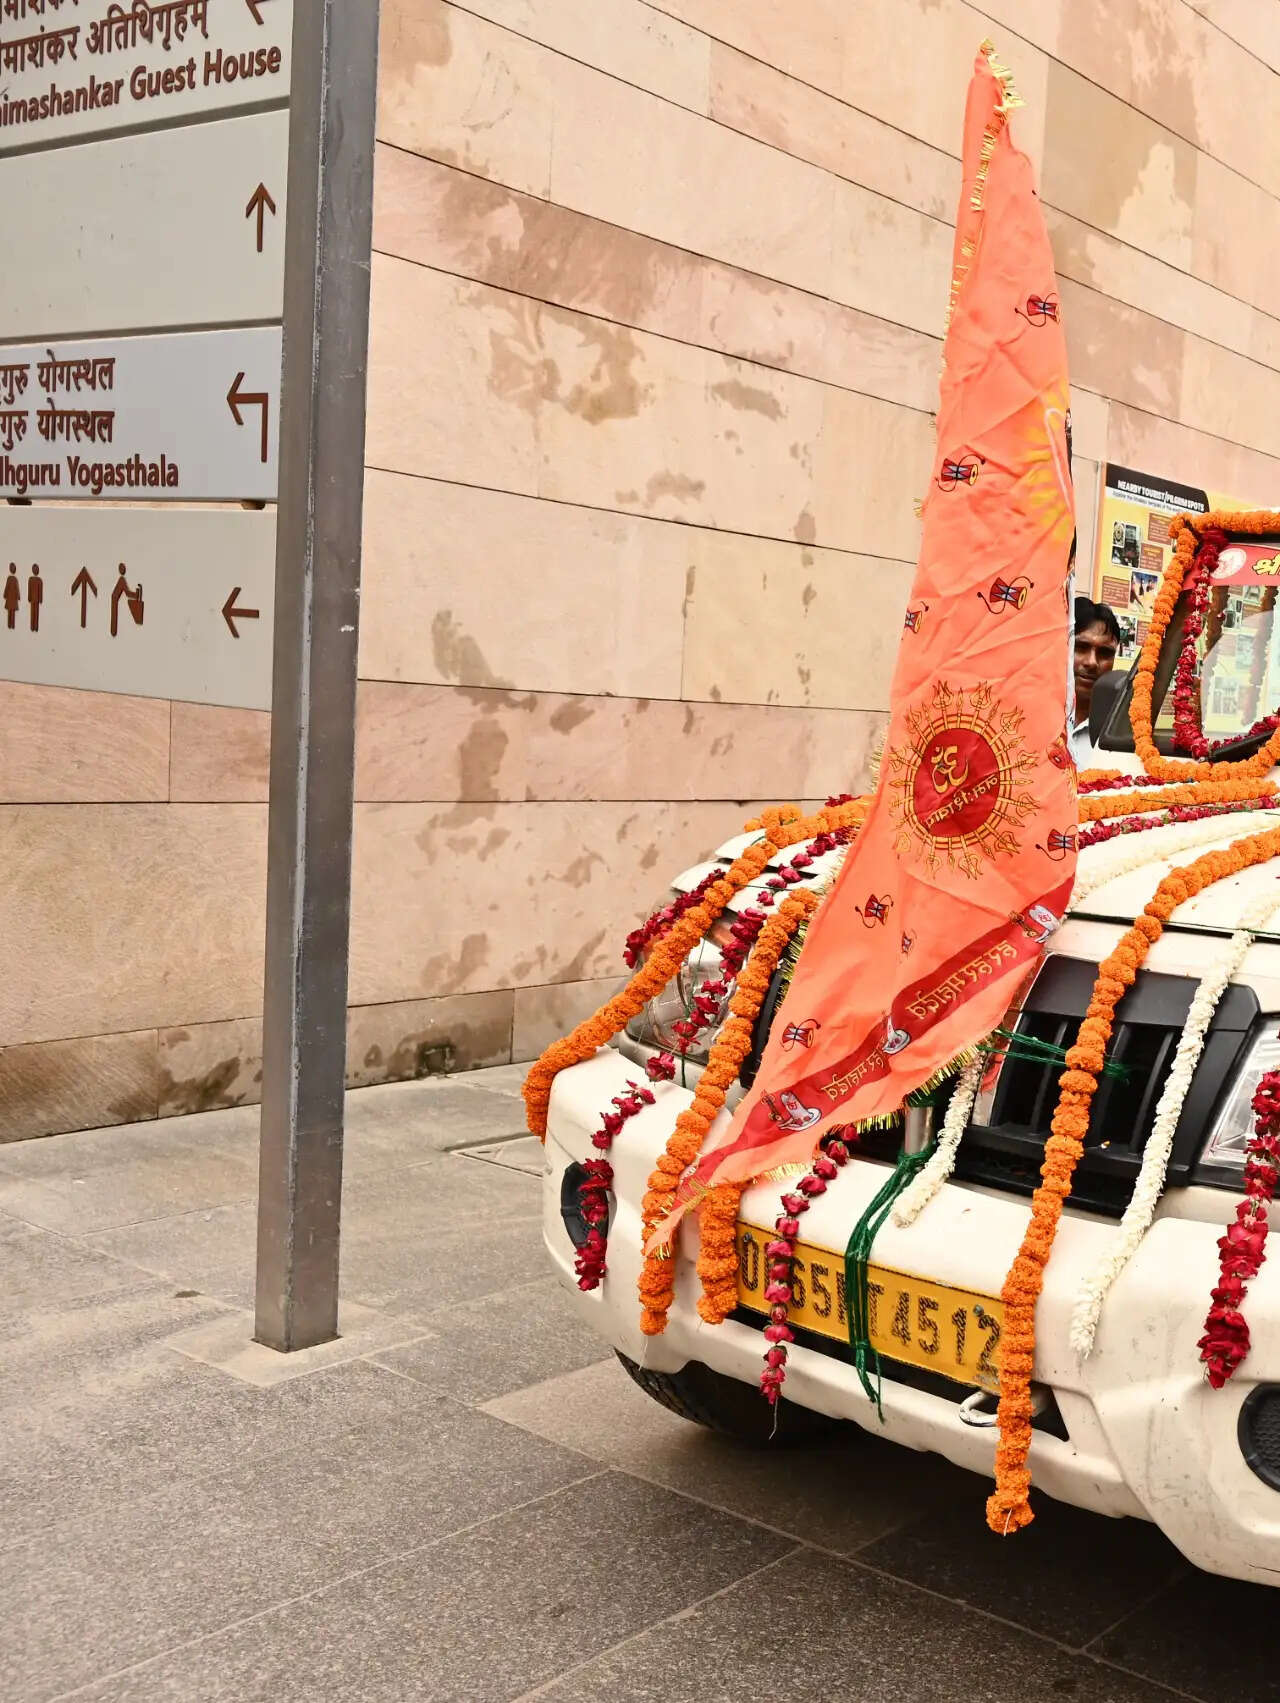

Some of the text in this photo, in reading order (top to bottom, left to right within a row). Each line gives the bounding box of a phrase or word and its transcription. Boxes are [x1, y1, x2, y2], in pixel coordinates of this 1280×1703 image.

[0, 25, 80, 76] माशंकर
[0, 46, 281, 127] imashankar Guest House
[37, 349, 115, 393] योगस्थल
[37, 397, 115, 443] योगस्थल
[67, 454, 179, 495] Yogasthala
